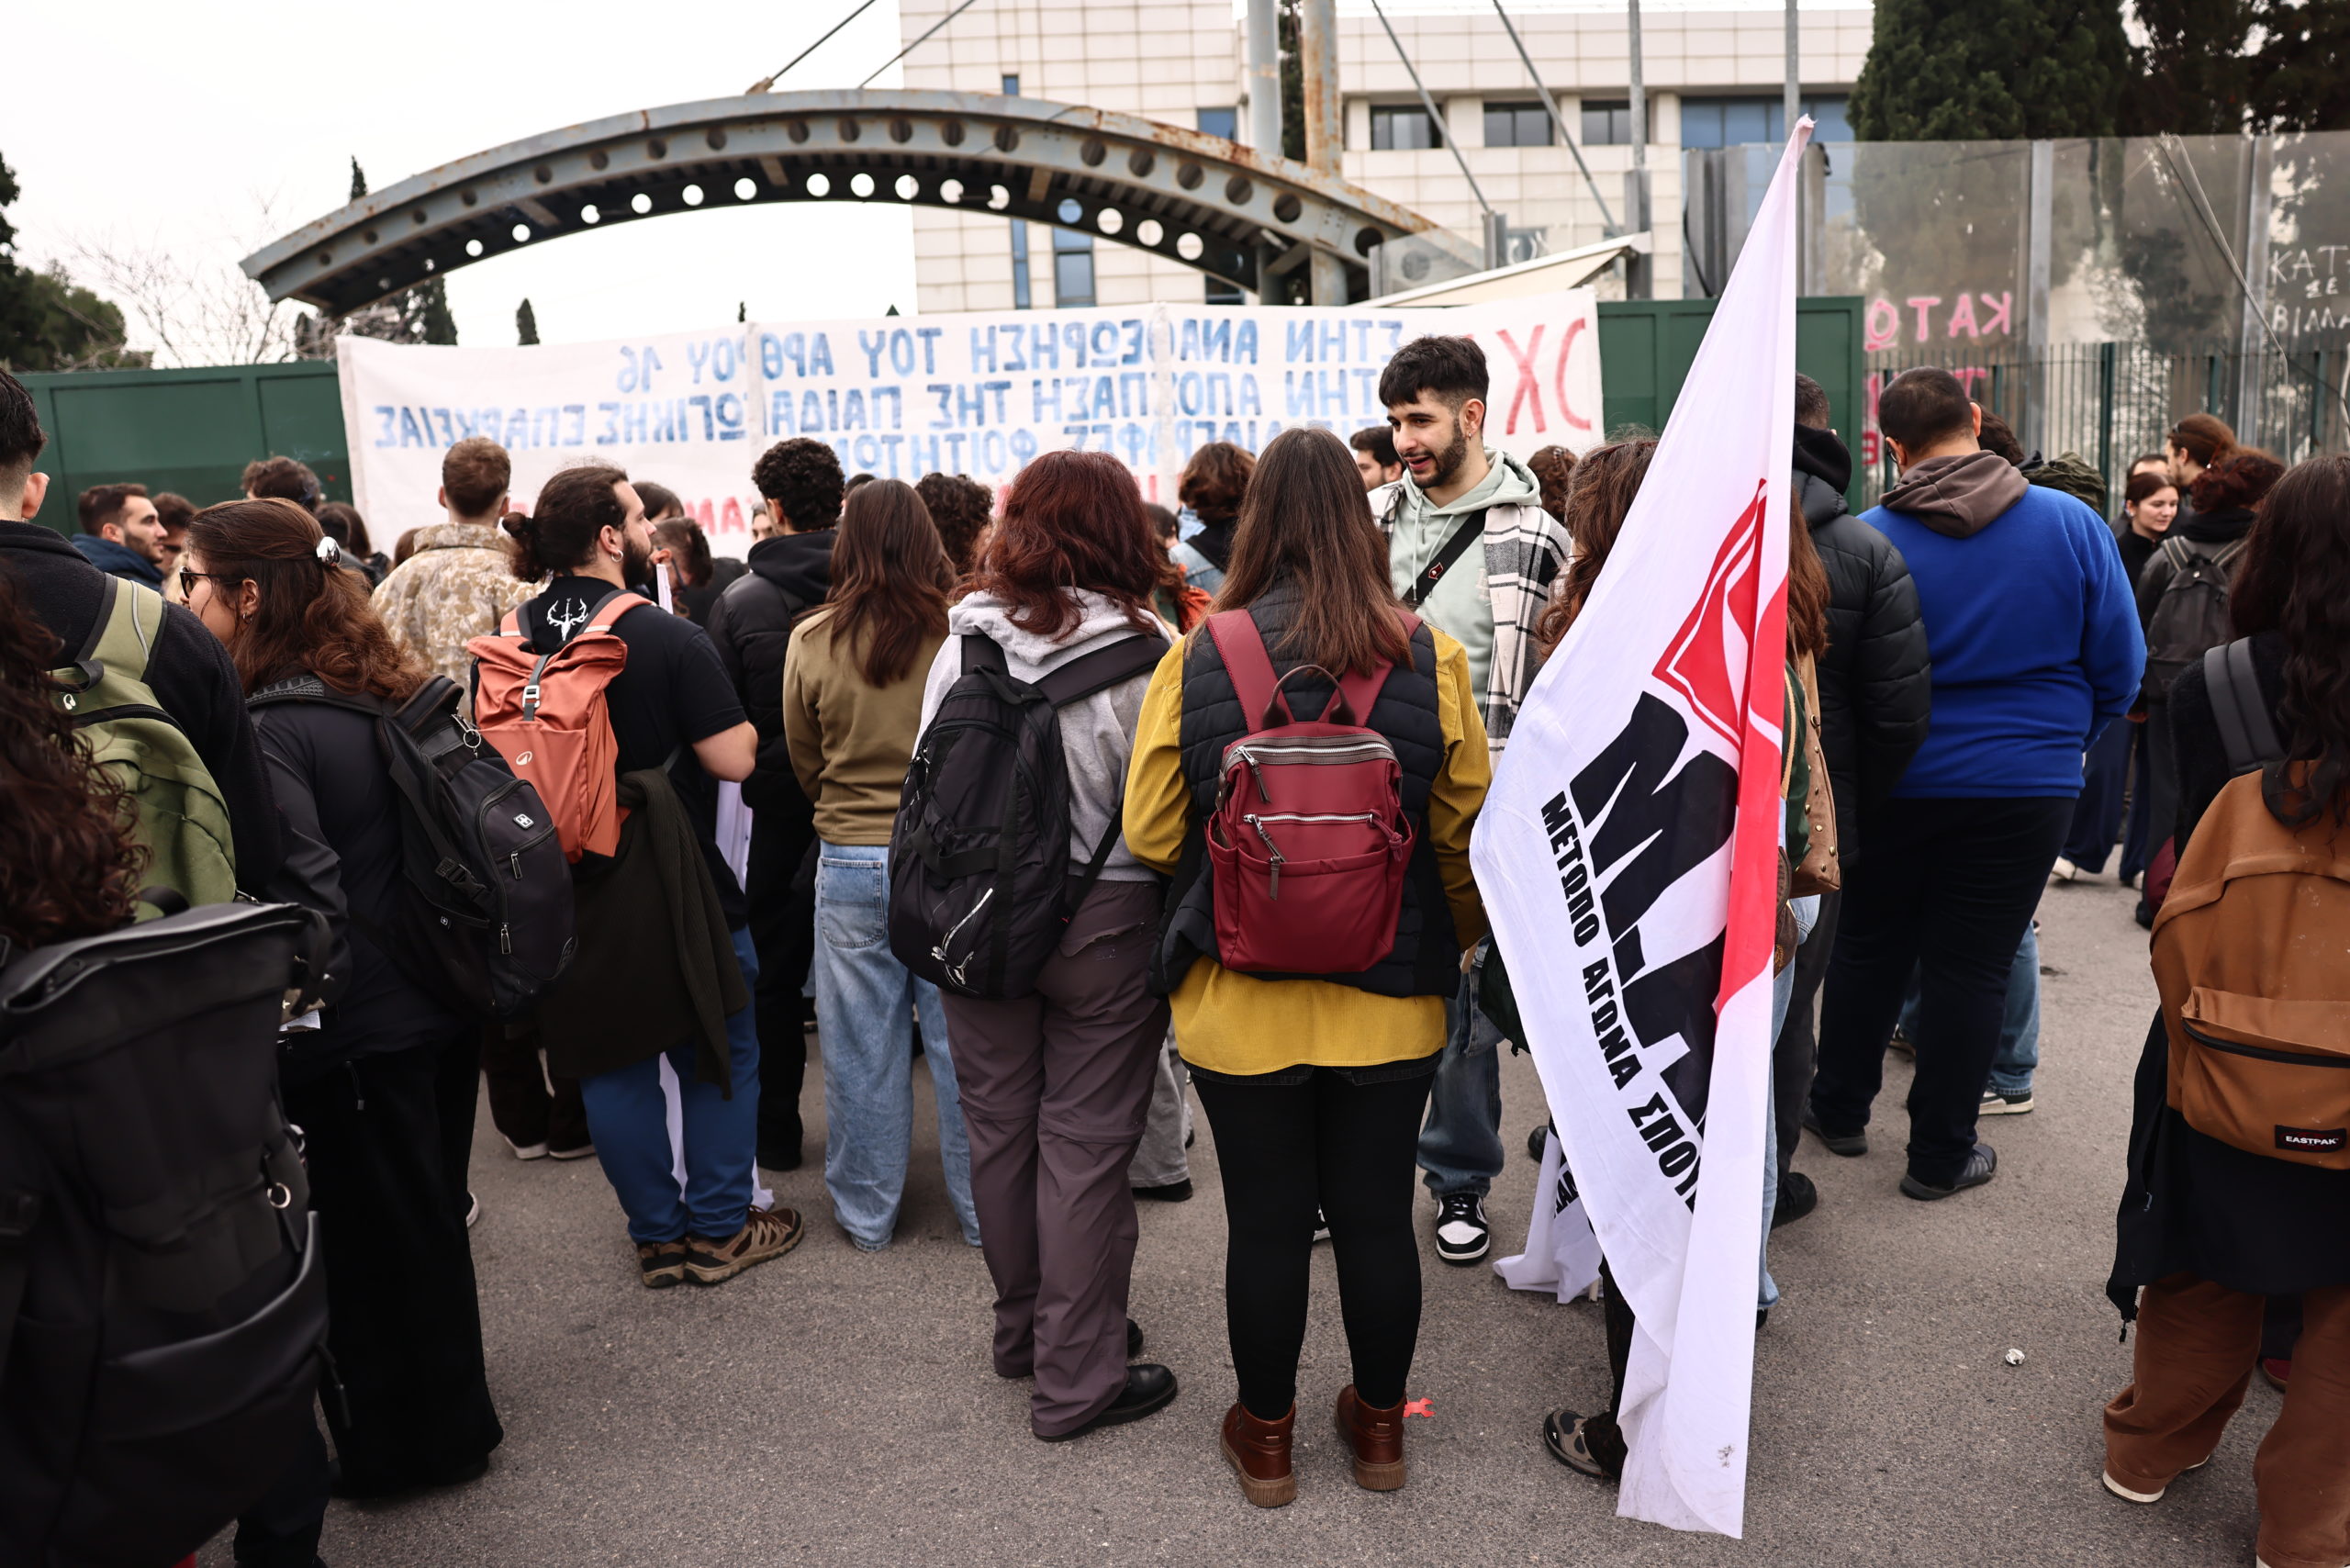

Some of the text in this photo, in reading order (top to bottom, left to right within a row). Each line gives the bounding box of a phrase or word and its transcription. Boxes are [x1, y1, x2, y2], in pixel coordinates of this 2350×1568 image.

[2269, 244, 2350, 286] ΚΑΤ
[1539, 790, 1702, 1215] ΜΕΤΩΠΟ ΑΓΩΝΑ ΣΠΟΥ
[2285, 1135, 2337, 1146] EASTPAK
